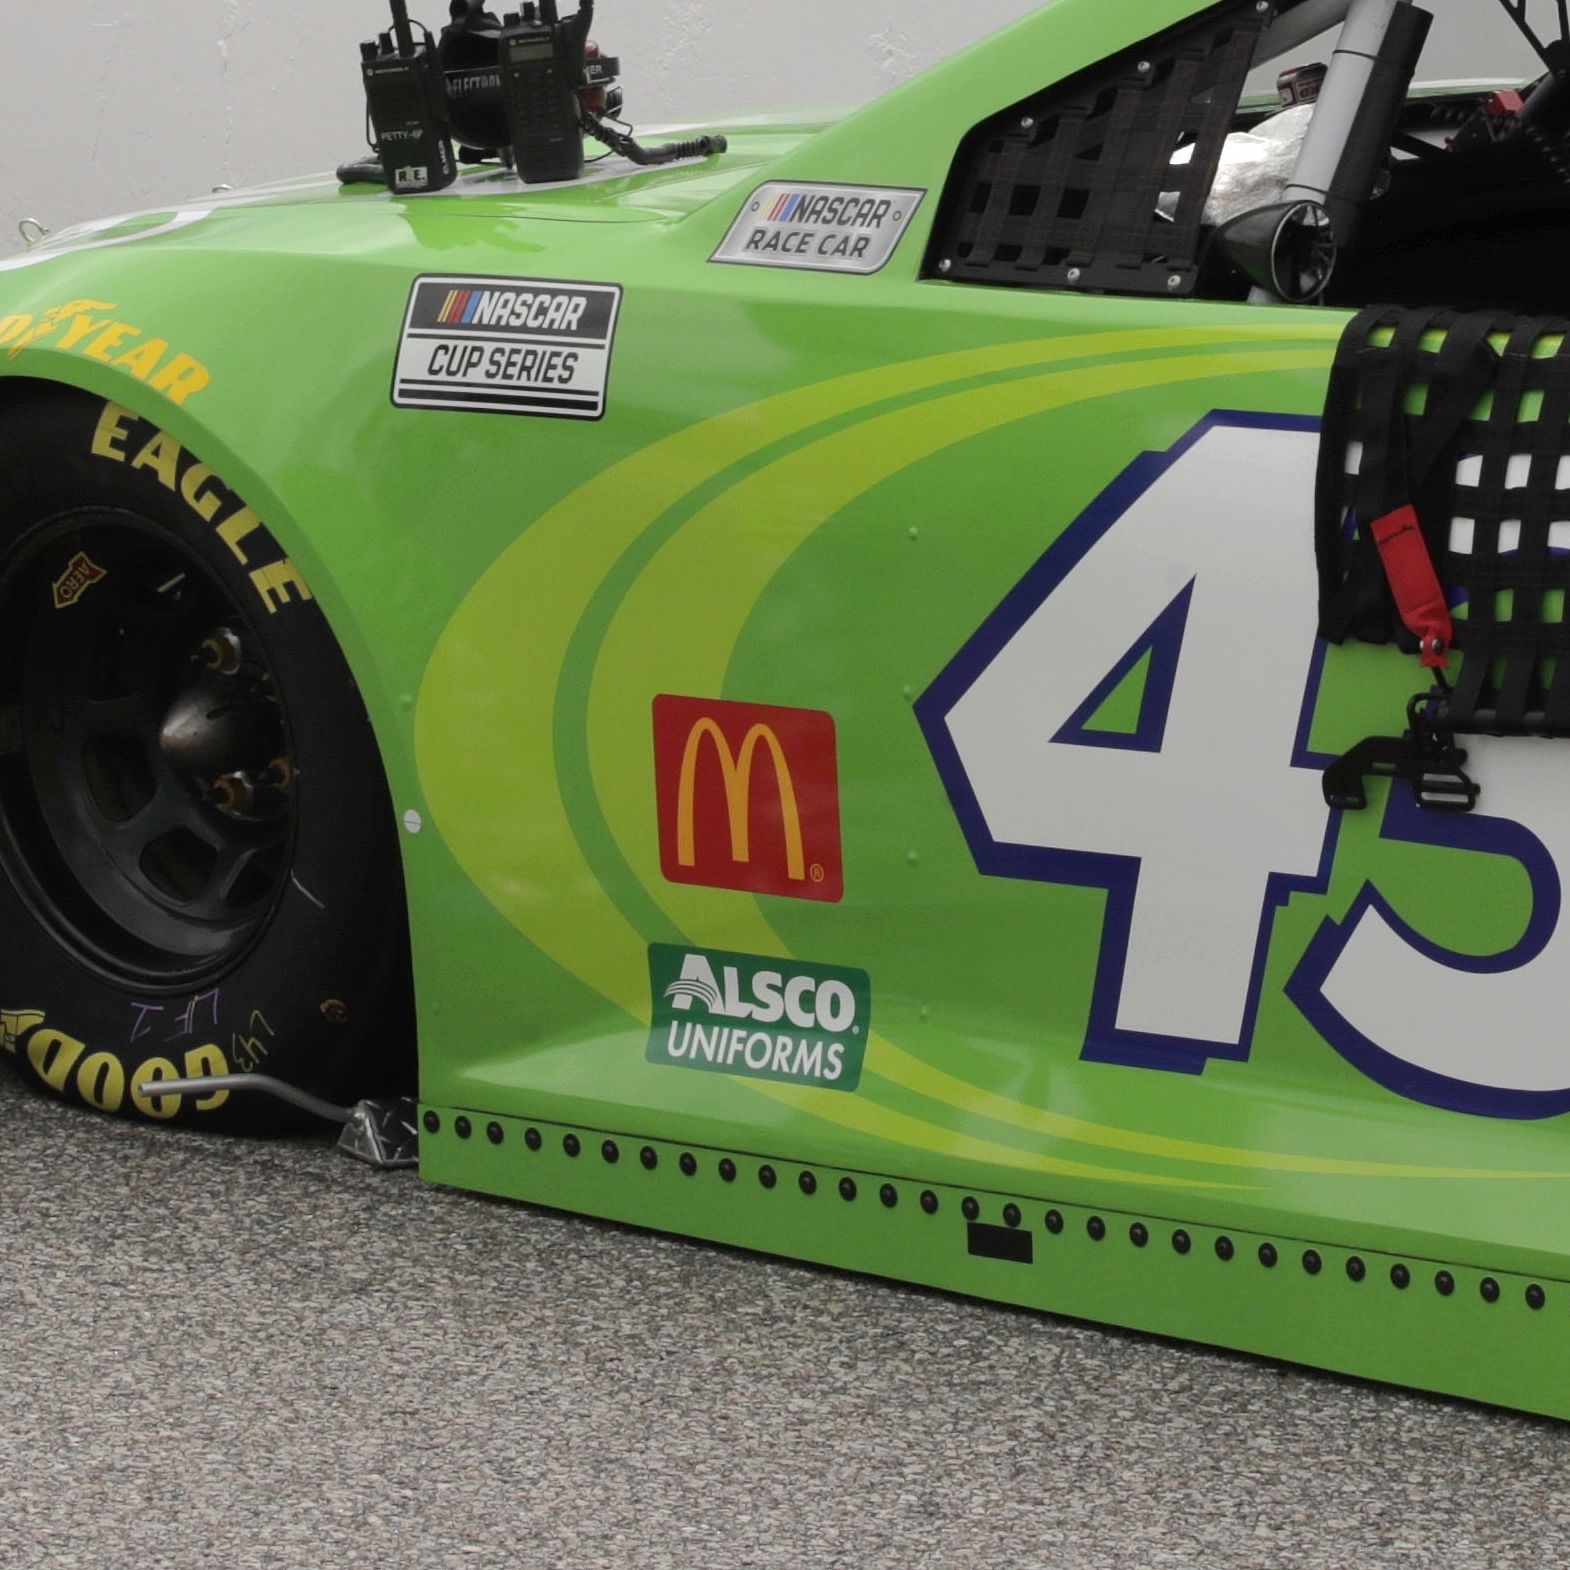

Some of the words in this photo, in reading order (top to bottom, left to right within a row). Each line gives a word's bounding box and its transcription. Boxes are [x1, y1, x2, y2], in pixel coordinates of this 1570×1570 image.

[790, 192, 892, 229] NASCAR
[745, 229, 814, 254] RACE
[817, 233, 871, 259] CAR
[470, 289, 588, 332] NASCAR
[427, 342, 486, 379] CUP
[491, 347, 580, 385] SERIES
[90, 400, 315, 618] EAGLE
[59, 562, 91, 599] AERO
[663, 953, 856, 1034] ALSCO
[666, 1020, 845, 1082] UNIFORMS
